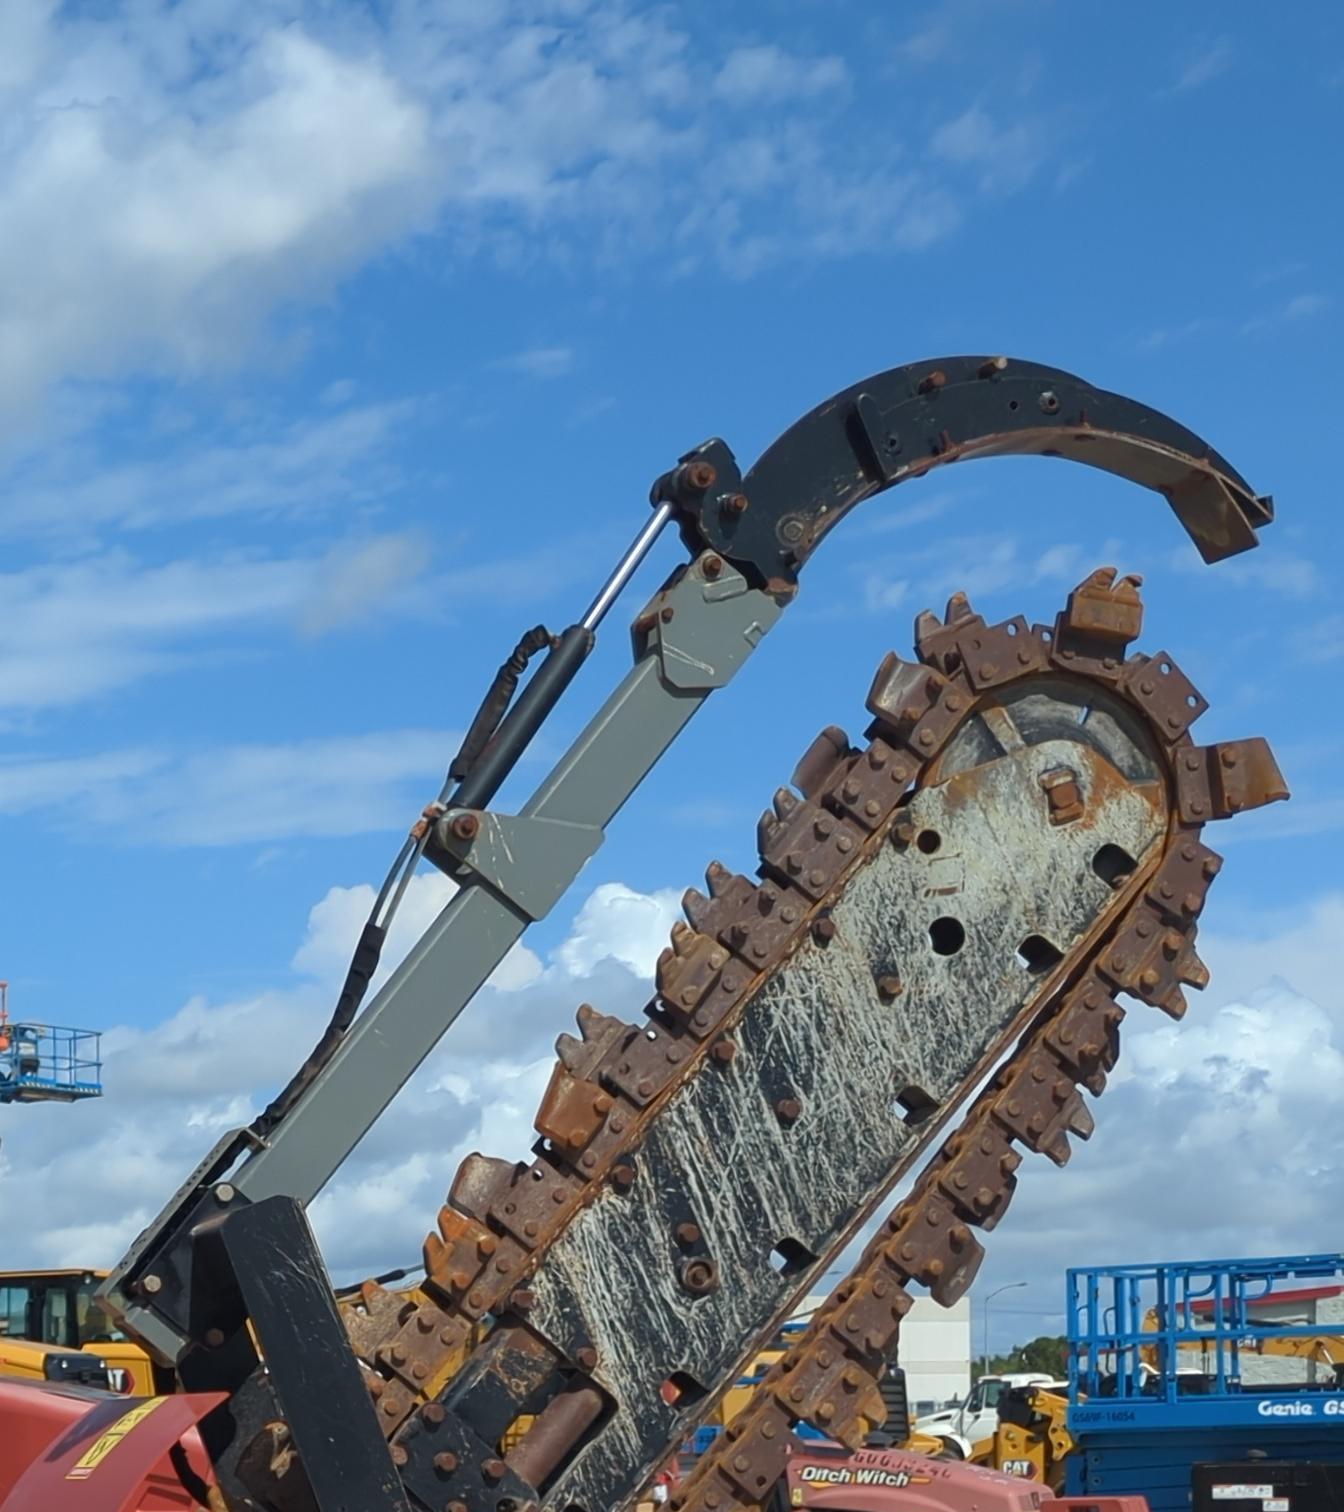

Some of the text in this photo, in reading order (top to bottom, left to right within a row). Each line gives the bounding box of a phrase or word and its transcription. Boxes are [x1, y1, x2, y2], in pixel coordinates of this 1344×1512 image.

[1257, 1400, 1313, 1416] Genie
[1002, 1460, 1030, 1476] CAT
[801, 1466, 910, 1487] Ditch Witch
